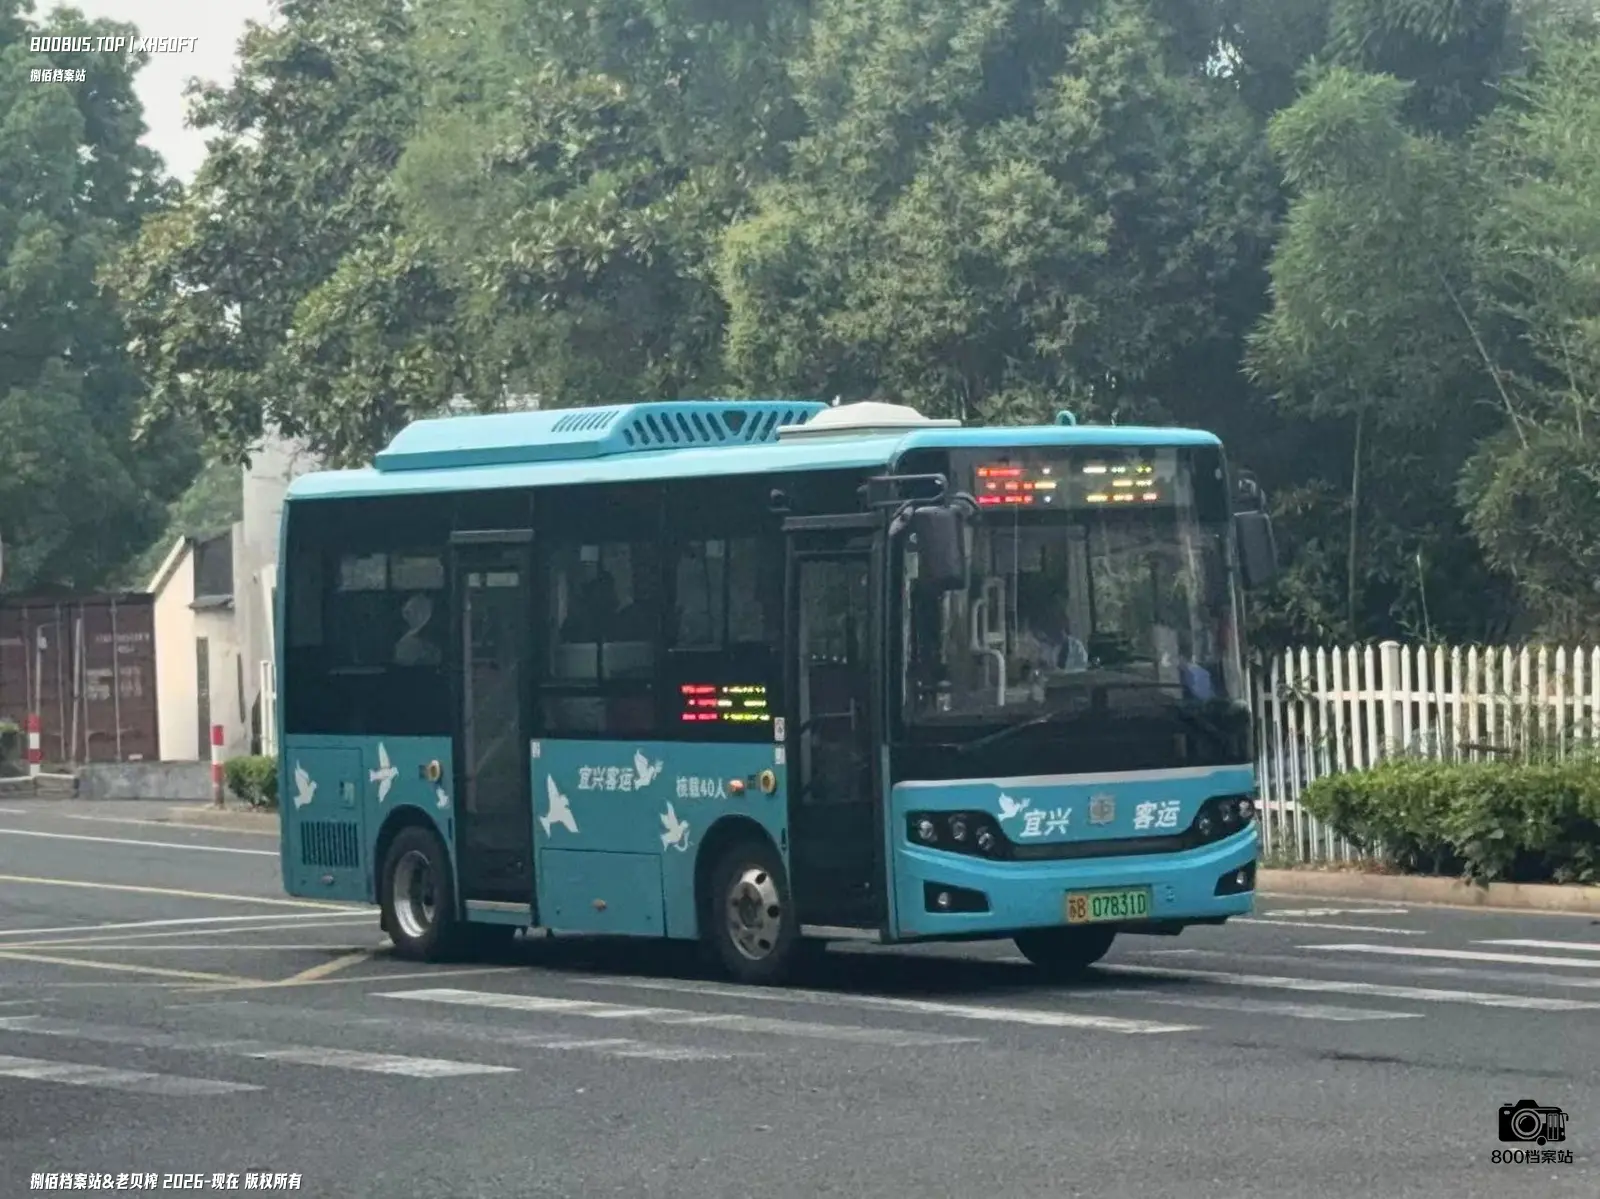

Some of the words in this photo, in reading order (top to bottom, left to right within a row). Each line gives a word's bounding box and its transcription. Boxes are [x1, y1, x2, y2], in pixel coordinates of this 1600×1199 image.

[578, 764, 634, 791] 宜兴客运
[1020, 808, 1073, 837] 宜兴
[1132, 800, 1181, 831] 客运
